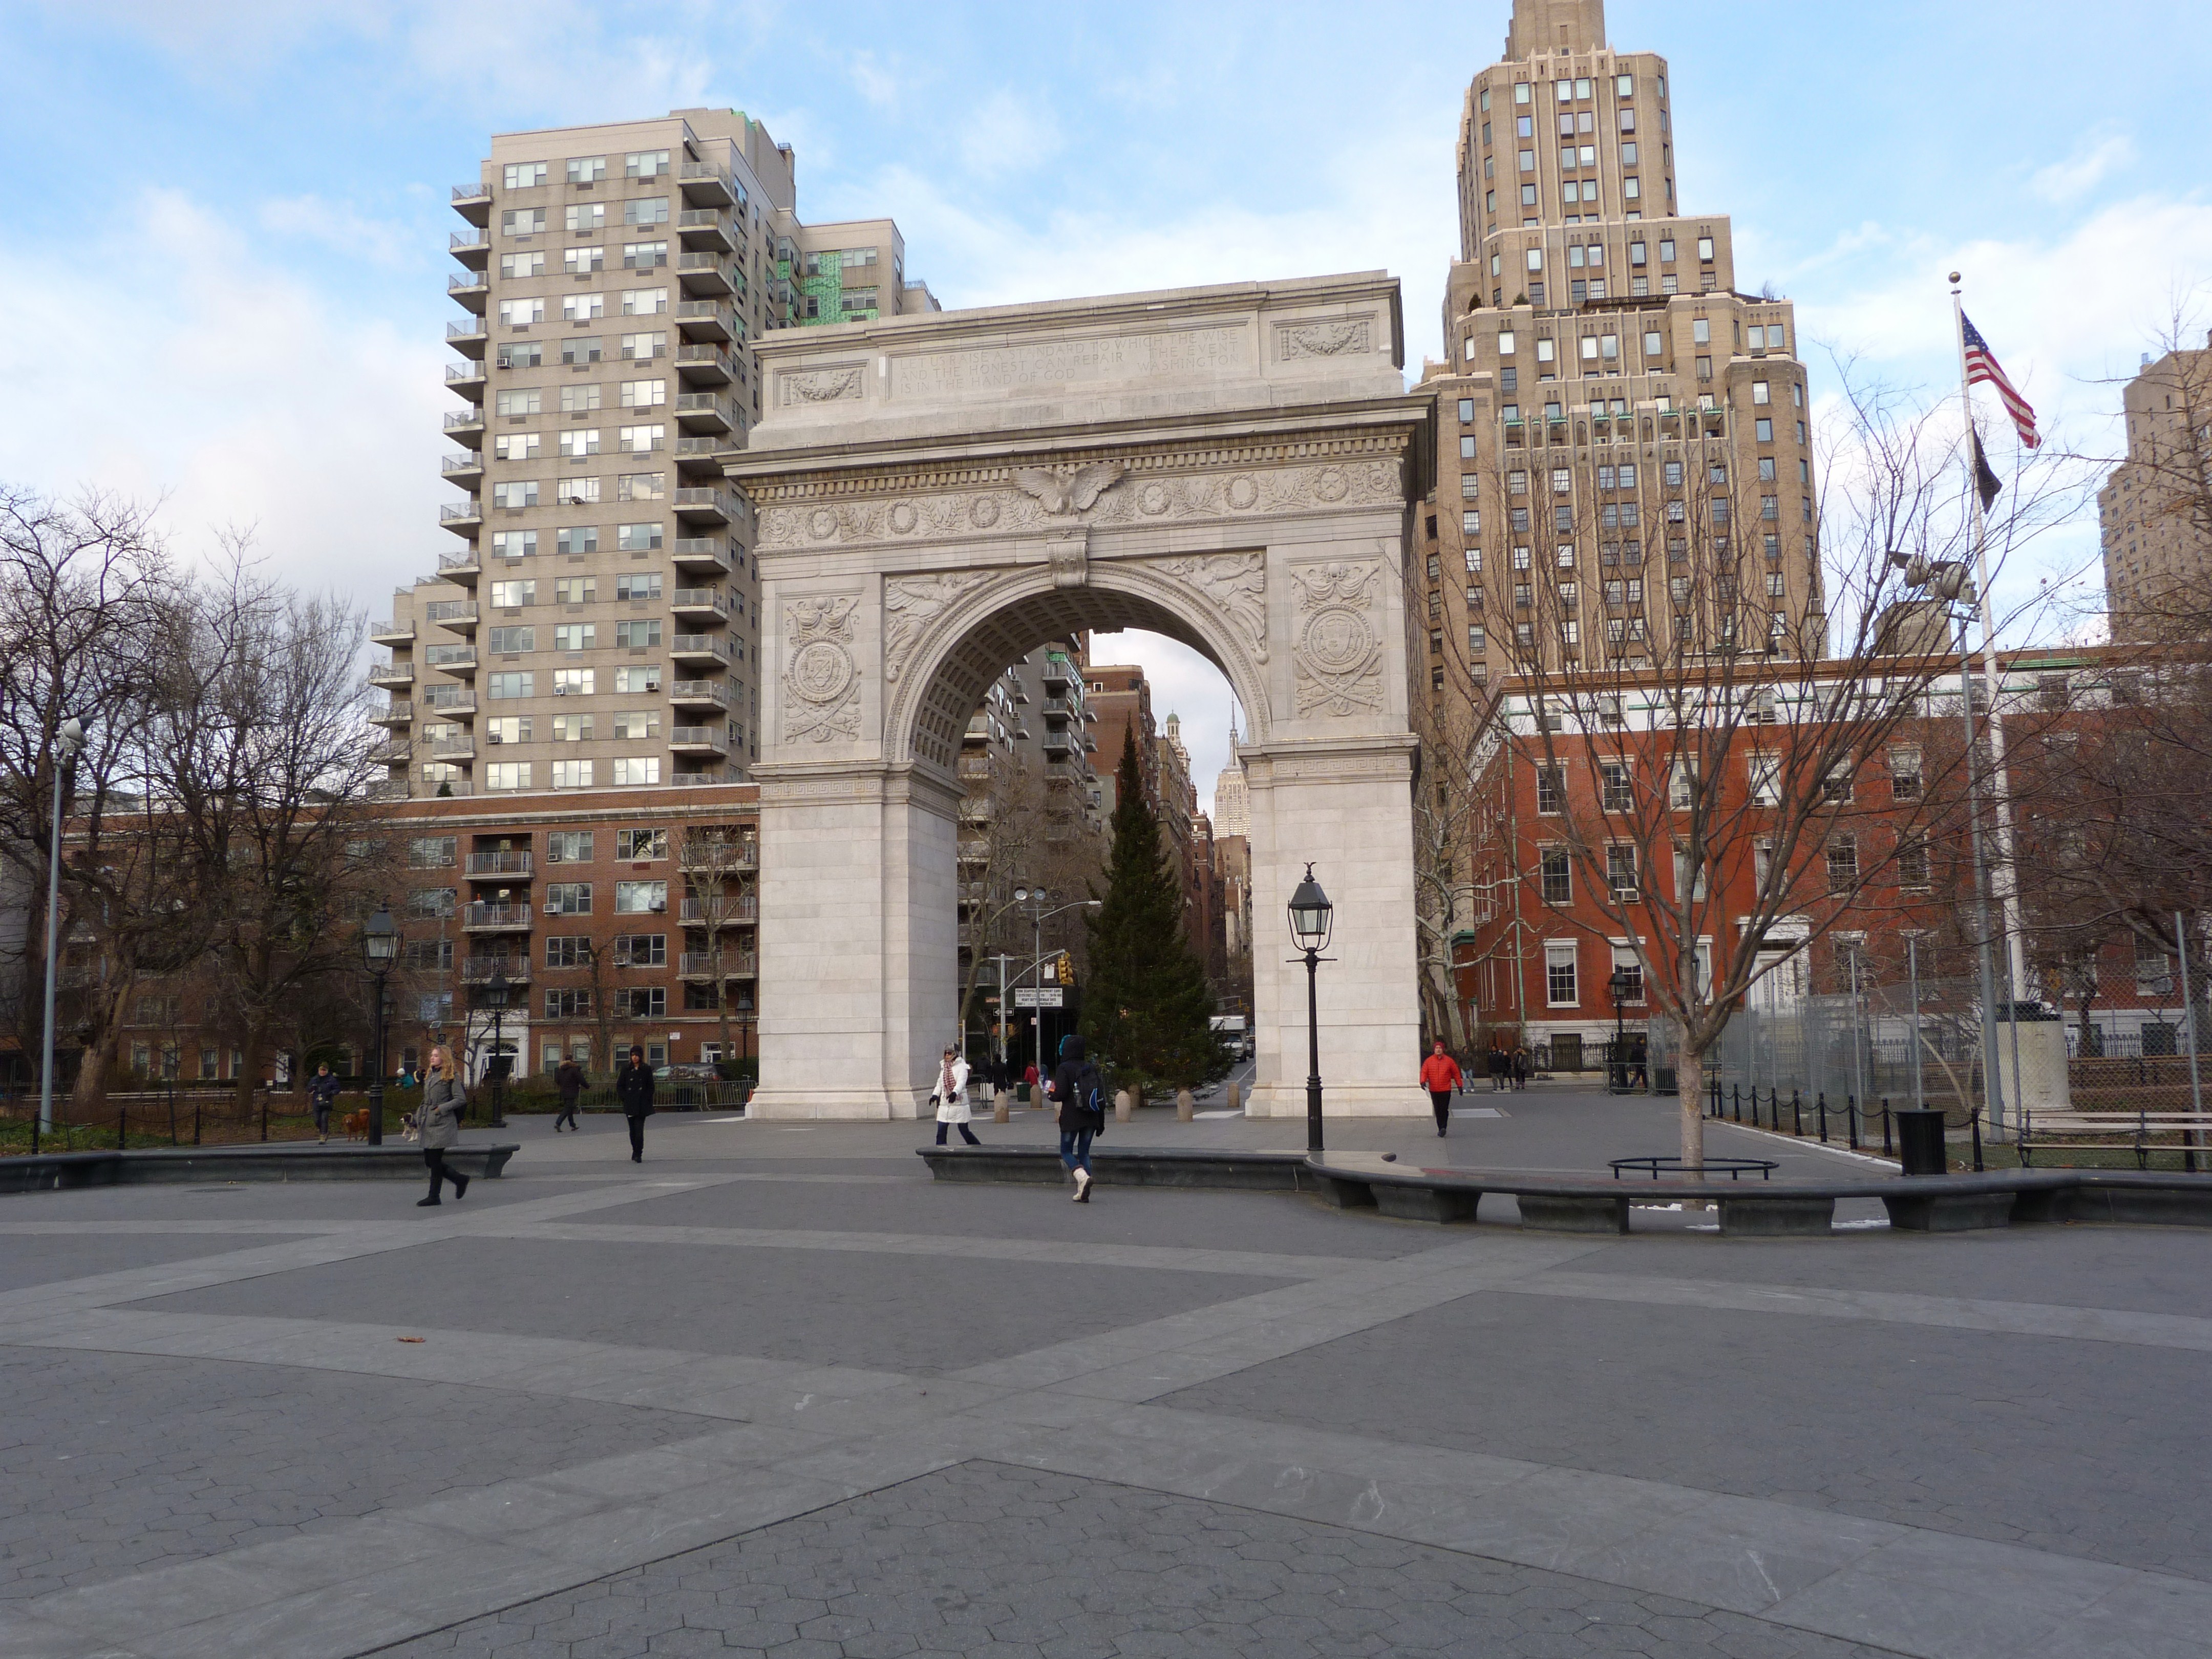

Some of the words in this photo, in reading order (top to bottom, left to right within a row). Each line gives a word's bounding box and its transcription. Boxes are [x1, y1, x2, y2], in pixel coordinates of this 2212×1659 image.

[900, 358, 926, 370] LET
[930, 357, 945, 367] US
[949, 351, 988, 366] RAISE
[994, 351, 1004, 361] A
[1009, 343, 1084, 359] STANDARD
[1090, 341, 1110, 353] TO
[1115, 335, 1163, 350] WHICH
[1167, 333, 1197, 345] THE
[1202, 329, 1238, 342] WISE
[900, 370, 927, 382] AND
[933, 366, 961, 378] THE
[969, 360, 1027, 375] HONEST
[1035, 358, 1066, 370] CAN
[1073, 352, 1123, 366] REPAIR
[1149, 347, 1179, 359] THE
[1187, 341, 1238, 356] EVENT
[901, 383, 911, 394] IS
[917, 382, 929, 392] IN
[936, 378, 964, 390] THE
[971, 374, 1012, 387] HAND
[1018, 372, 1037, 382] OF
[1044, 368, 1075, 380] GOD
[1137, 354, 1239, 372] WASHINGTON
